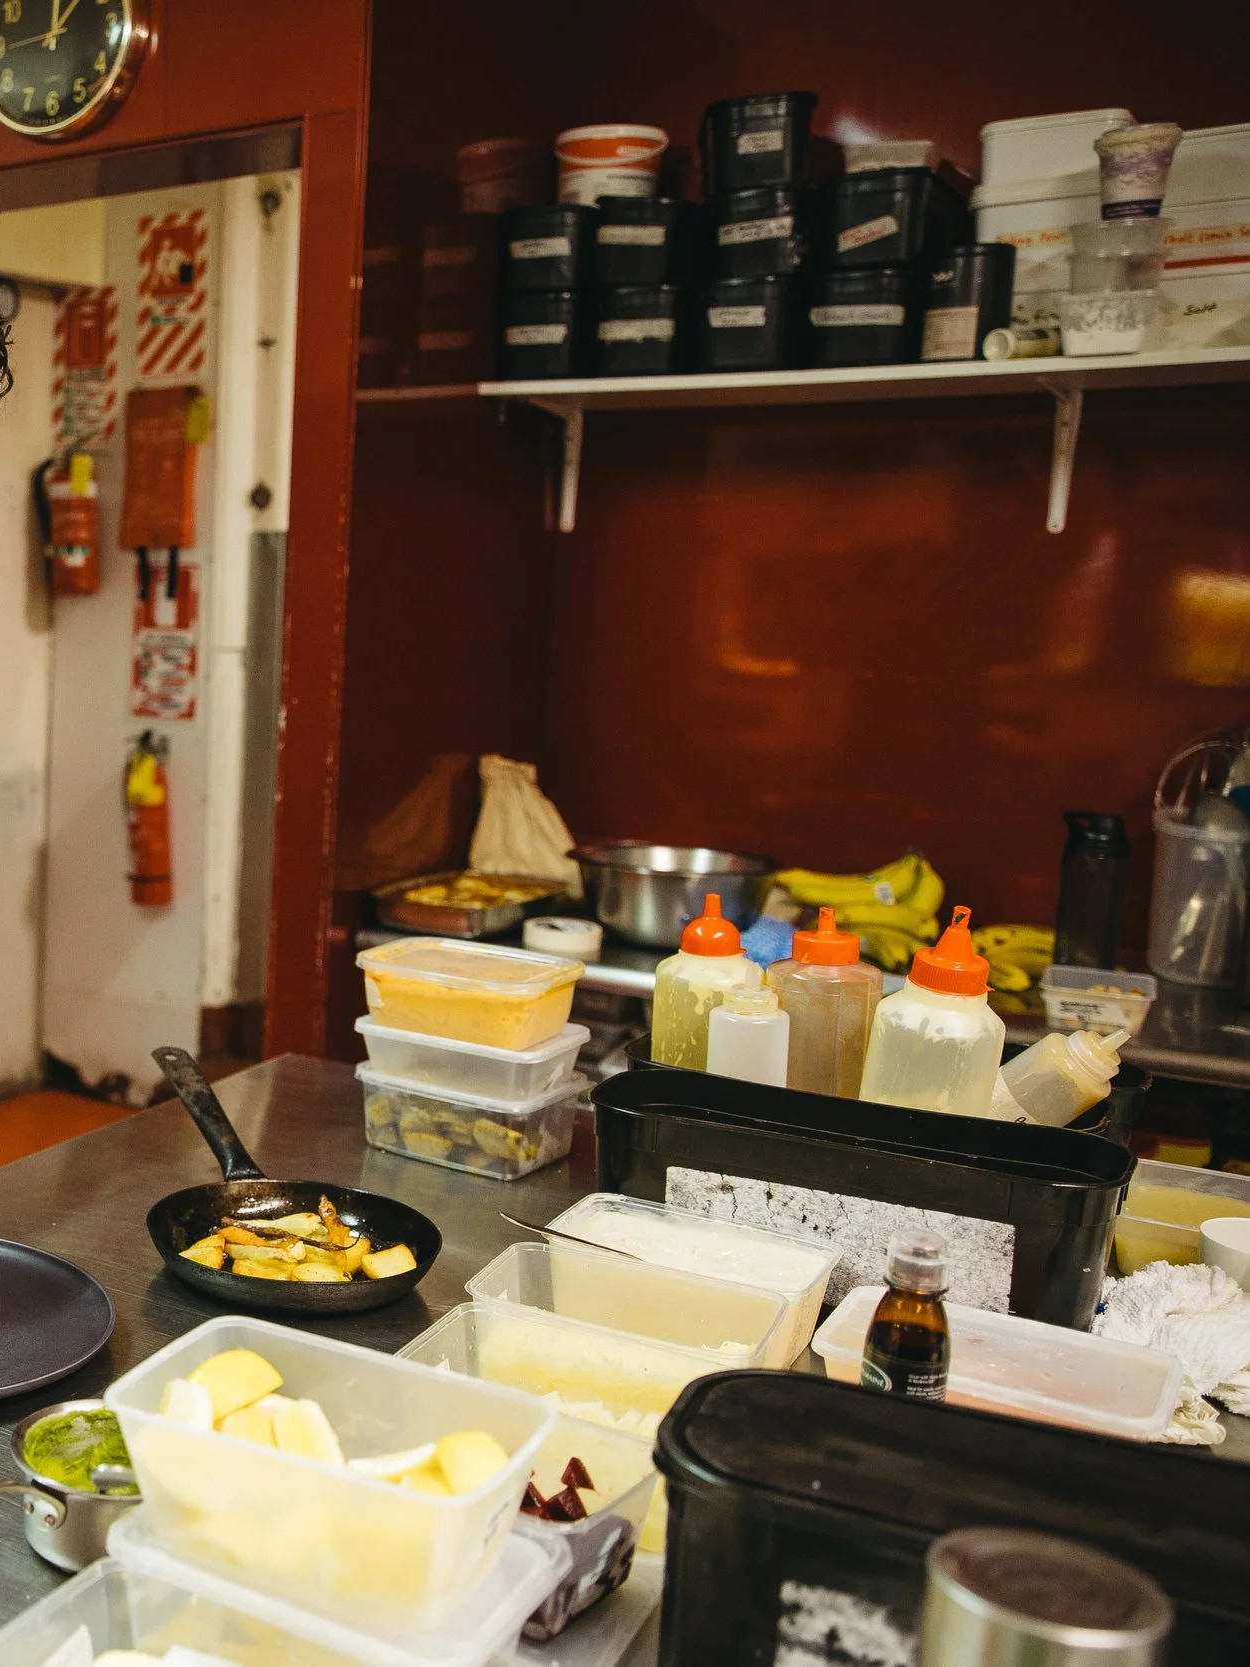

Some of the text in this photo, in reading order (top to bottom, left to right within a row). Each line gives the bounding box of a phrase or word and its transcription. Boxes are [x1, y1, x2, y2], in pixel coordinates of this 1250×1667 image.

[3, 0, 22, 24] 10
[93, 50, 107, 74] 4
[1, 68, 14, 93] 8
[73, 77, 86, 103] 5
[22, 86, 35, 112] 7
[45, 91, 59, 116] 6
